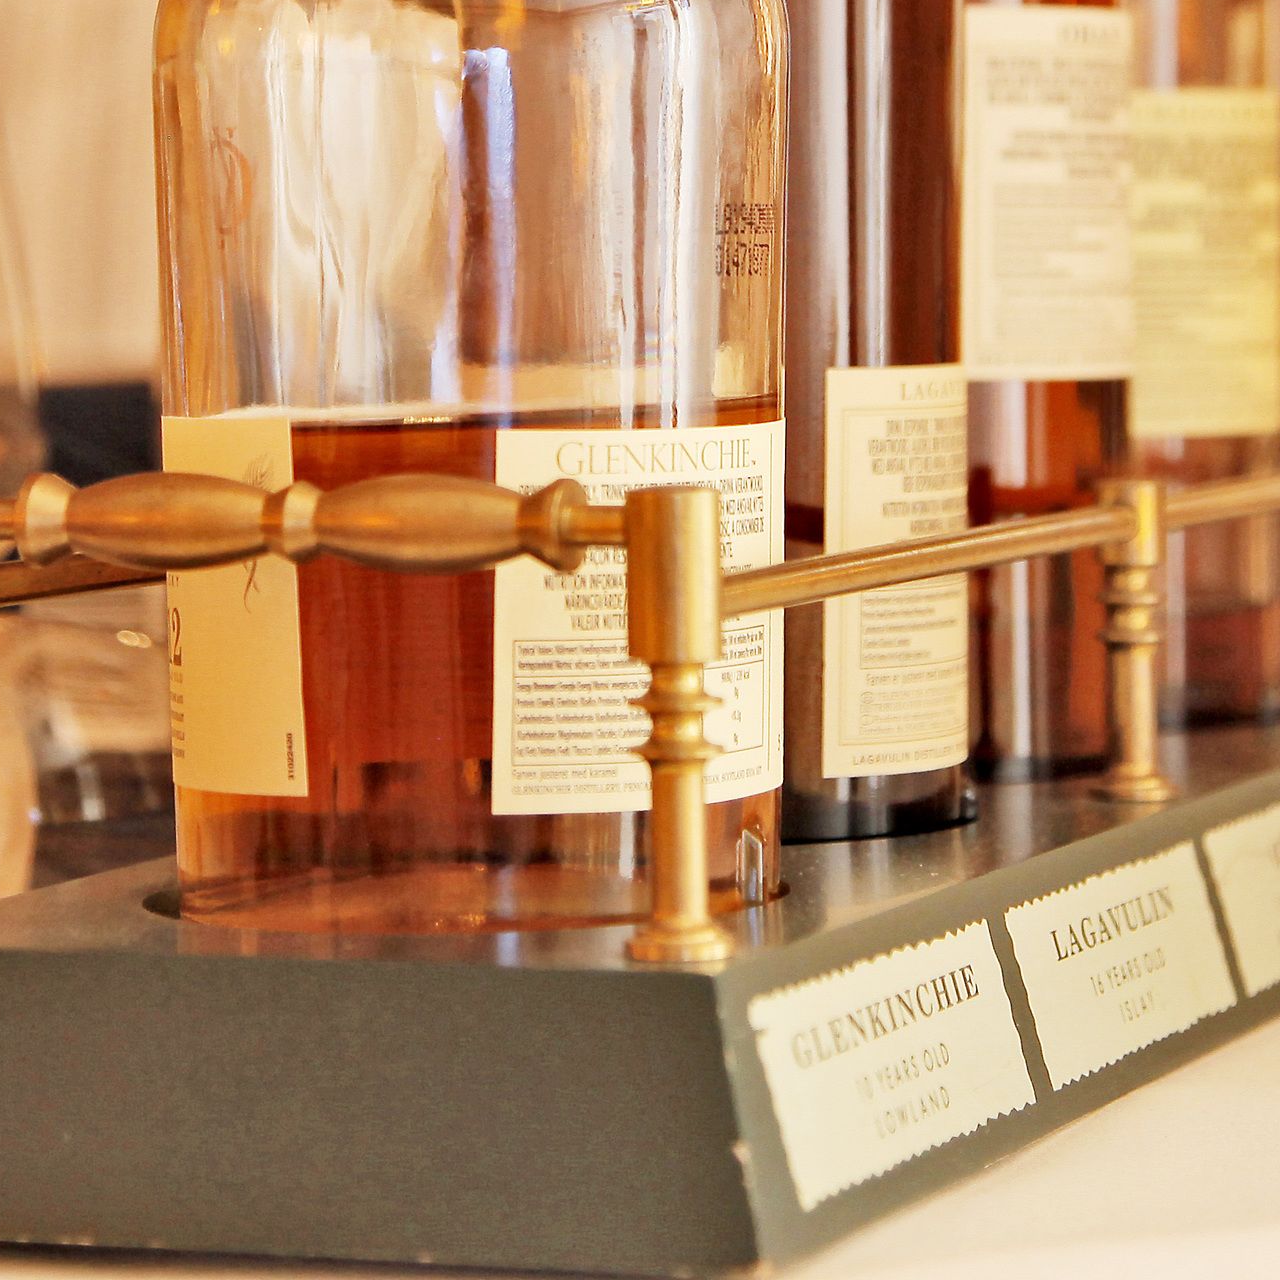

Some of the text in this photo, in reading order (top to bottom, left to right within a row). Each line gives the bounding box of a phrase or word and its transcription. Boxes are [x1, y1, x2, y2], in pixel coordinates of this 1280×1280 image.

[556, 439, 751, 476] GLENKINCHIE
[1050, 886, 1176, 962] LAGAVULIN
[1106, 957, 1142, 988] YEARS
[790, 965, 980, 1070] GLENKINCHIE
[877, 1054, 921, 1091] YEARS
[923, 1042, 951, 1073] OLD
[874, 1085, 951, 1139] LOWLAND
